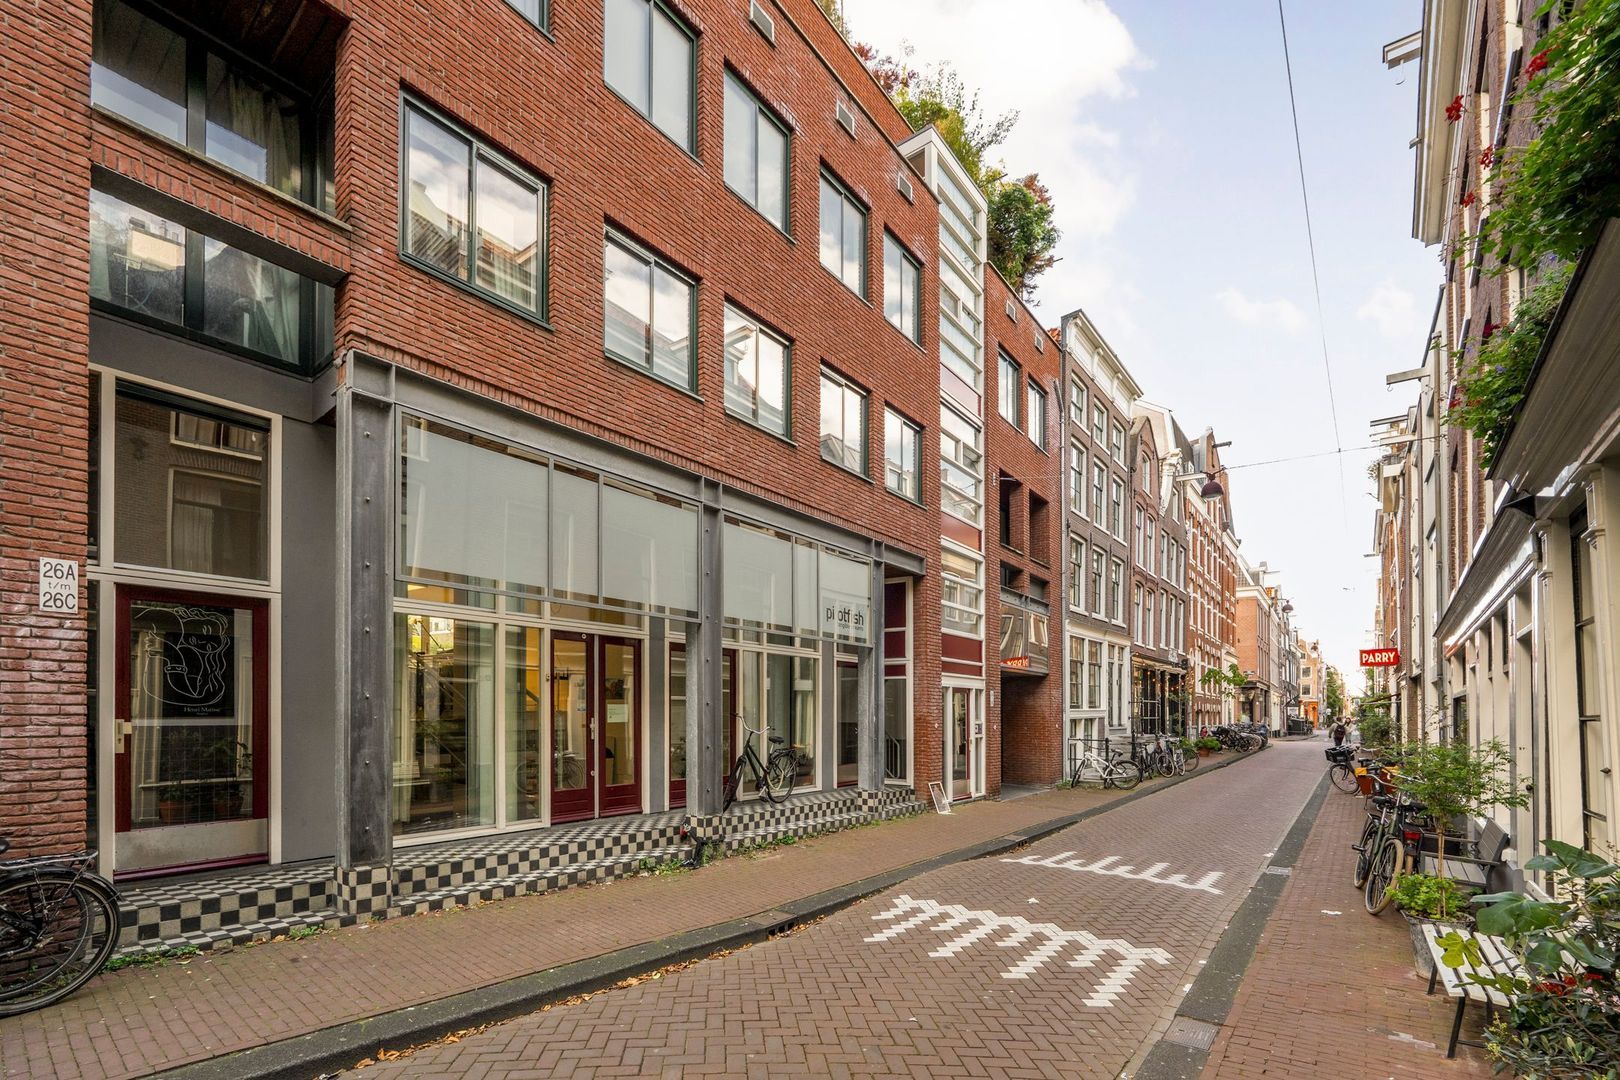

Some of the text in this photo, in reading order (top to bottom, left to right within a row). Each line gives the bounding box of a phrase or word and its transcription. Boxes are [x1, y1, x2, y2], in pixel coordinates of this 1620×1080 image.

[43, 561, 76, 581] 26A
[48, 581, 71, 591] t/m
[42, 591, 76, 610] 26C
[826, 605, 864, 625] piotfsh
[1361, 652, 1395, 663] PARRY
